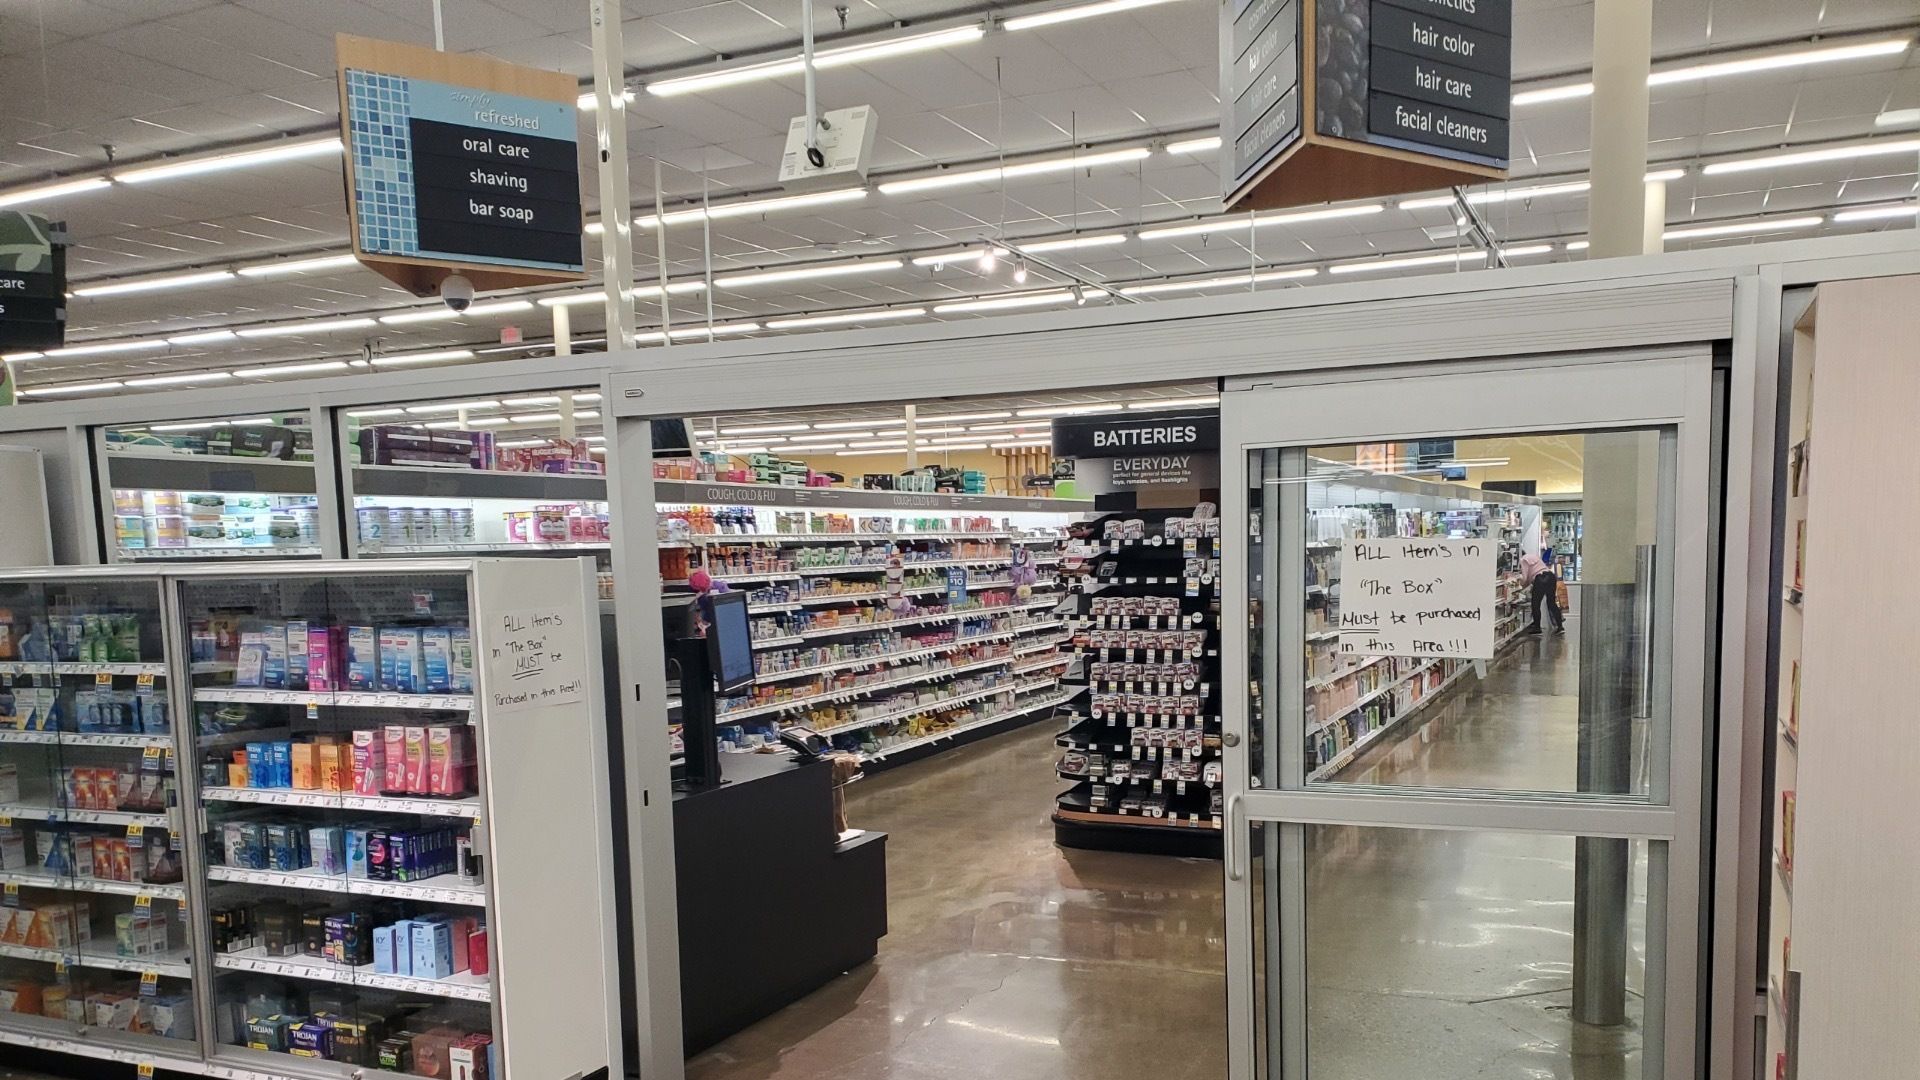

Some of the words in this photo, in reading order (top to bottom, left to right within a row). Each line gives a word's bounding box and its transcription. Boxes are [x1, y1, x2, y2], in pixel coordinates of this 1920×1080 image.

[1413, 22, 1439, 48] hair
[1443, 34, 1475, 57] color
[1415, 65, 1441, 92] hair
[1445, 77, 1472, 99] care
[475, 109, 540, 130] refreshed
[1395, 105, 1432, 133] facial
[1436, 115, 1487, 144] cleaners
[462, 138, 492, 153] oral
[499, 143, 530, 159] care
[470, 169, 528, 193] shaving
[469, 199, 494, 216] bar
[499, 206, 534, 224] soap
[1094, 426, 1197, 447] BATTERIES
[1113, 456, 1190, 471] EVERYDAY
[707, 488, 735, 502] COUGH,
[737, 489, 756, 501] COLD
[757, 490, 763, 501] &
[763, 491, 776, 502] FLU
[1355, 544, 1391, 561] ALL
[1463, 545, 1480, 558] in
[950, 578, 964, 586] $10
[503, 615, 525, 633] ALL
[1391, 610, 1406, 624] be
[1416, 608, 1481, 626] purchased
[1341, 643, 1354, 653] in
[1366, 638, 1395, 652] this
[515, 653, 544, 673] MUST
[550, 652, 562, 663] be
[494, 690, 528, 707] Purchased
[540, 688, 556, 699] this
[249, 1024, 274, 1034] TROJAN
[292, 1030, 317, 1042] TROJAN
